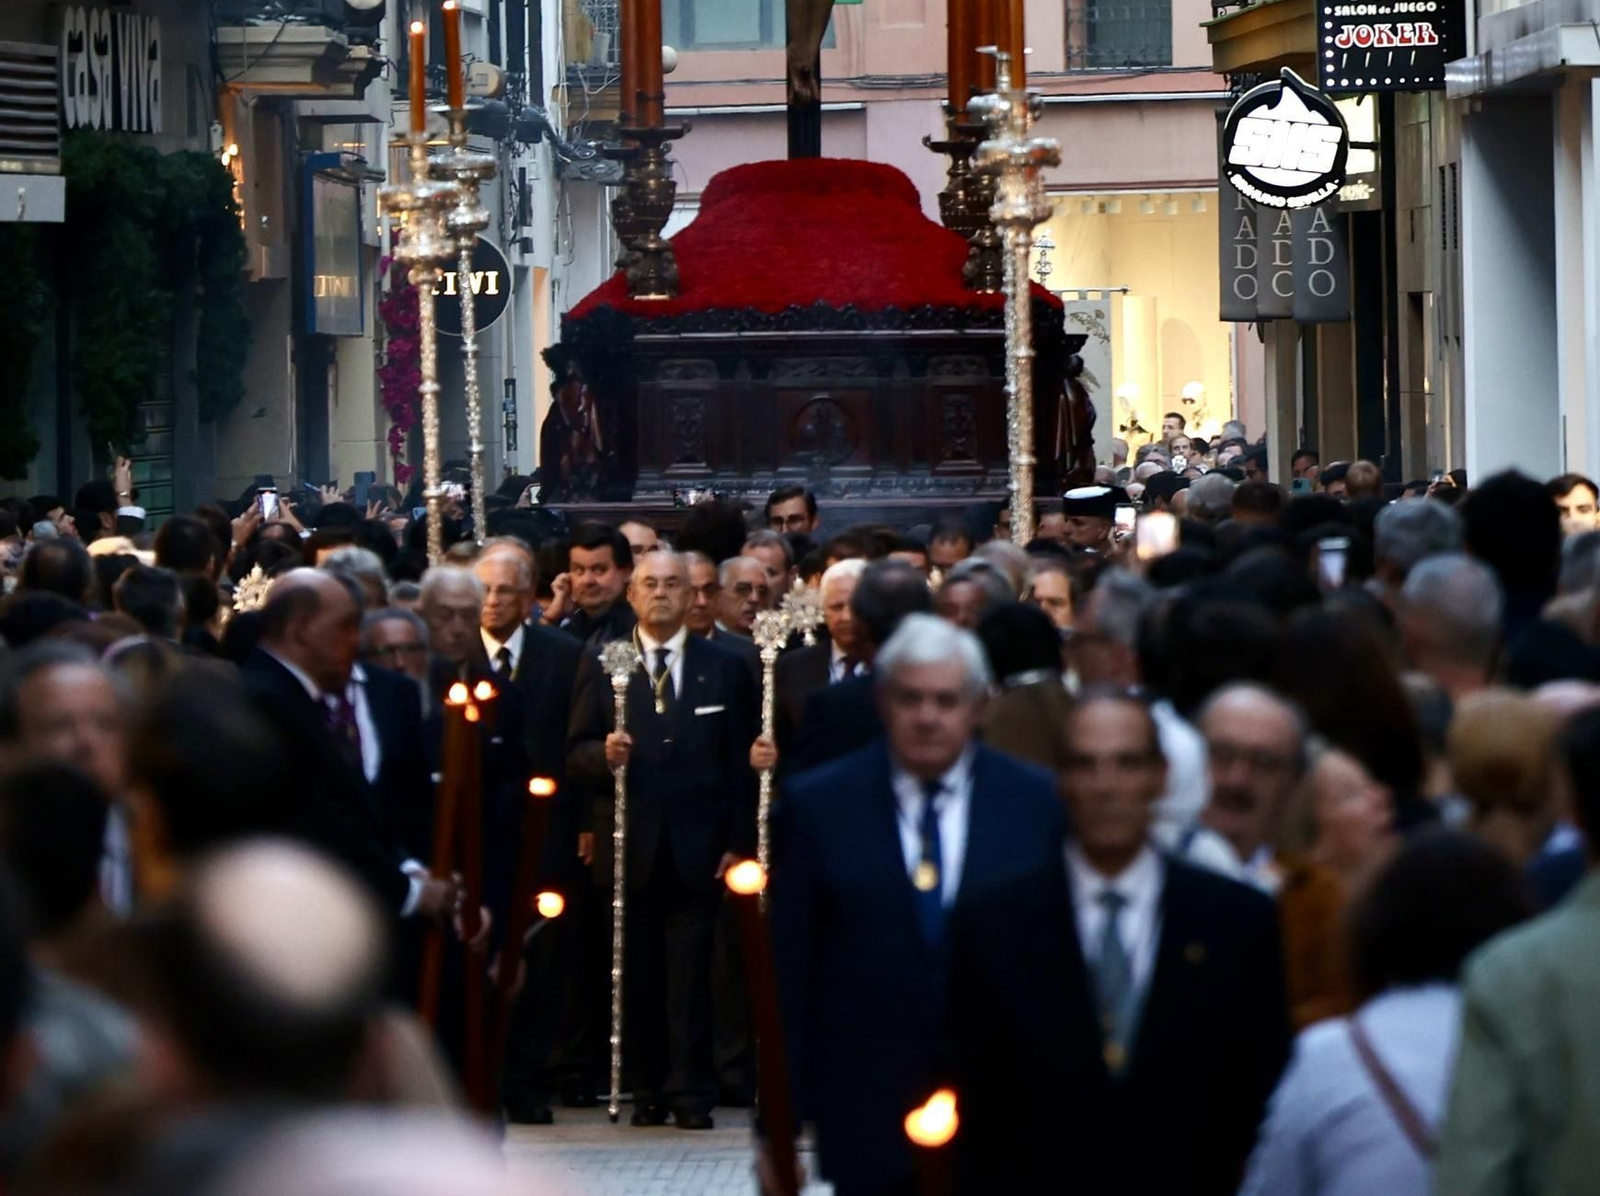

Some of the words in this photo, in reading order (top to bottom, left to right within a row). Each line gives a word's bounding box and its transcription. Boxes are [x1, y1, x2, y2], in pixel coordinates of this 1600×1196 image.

[1334, 4, 1377, 16] SALON
[1378, 6, 1391, 14] de
[1393, 1, 1437, 13] JUEGO
[1335, 22, 1438, 48] JOKER
[1287, 183, 1338, 207] SEVILLA
